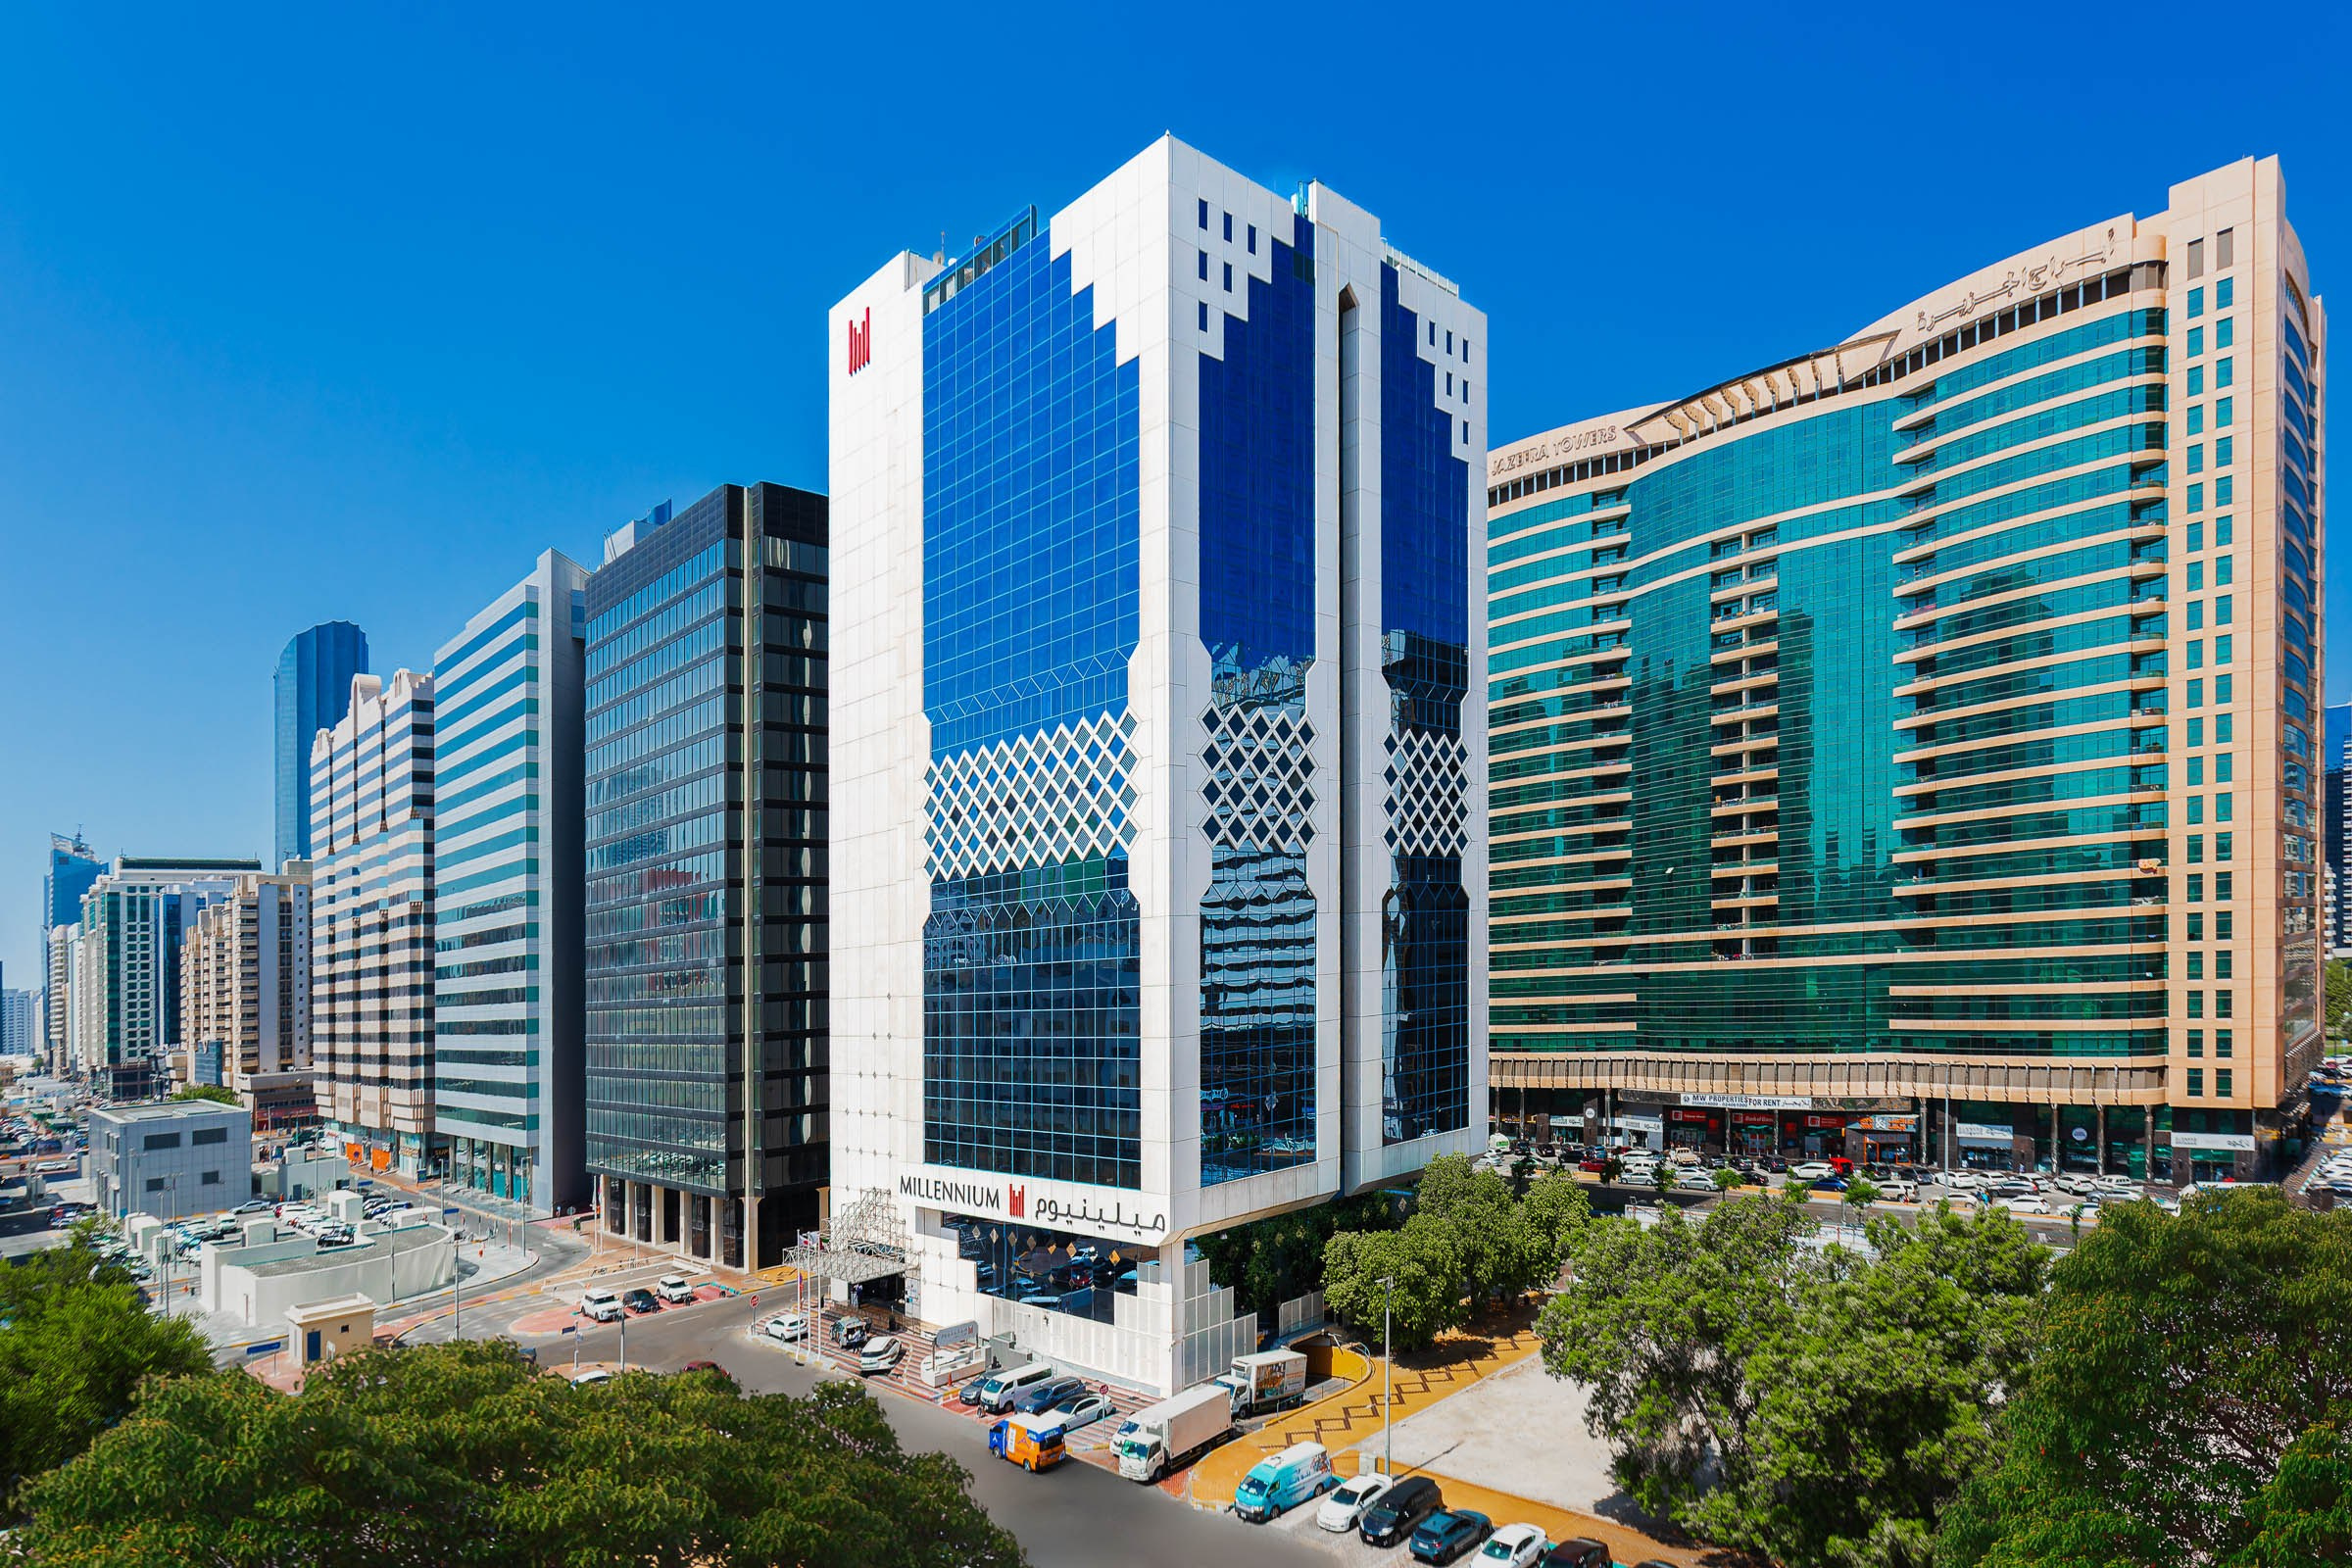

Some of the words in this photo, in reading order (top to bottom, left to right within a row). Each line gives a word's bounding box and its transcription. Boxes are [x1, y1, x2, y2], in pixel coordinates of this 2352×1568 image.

[1553, 425, 1617, 456] TOWERS
[1709, 1095, 1748, 1103] PROPERTIES
[1748, 1098, 1762, 1106] FOR
[900, 1175, 1001, 1210] MILLENNIUM
[1035, 1197, 1166, 1237] ميلينيوم
